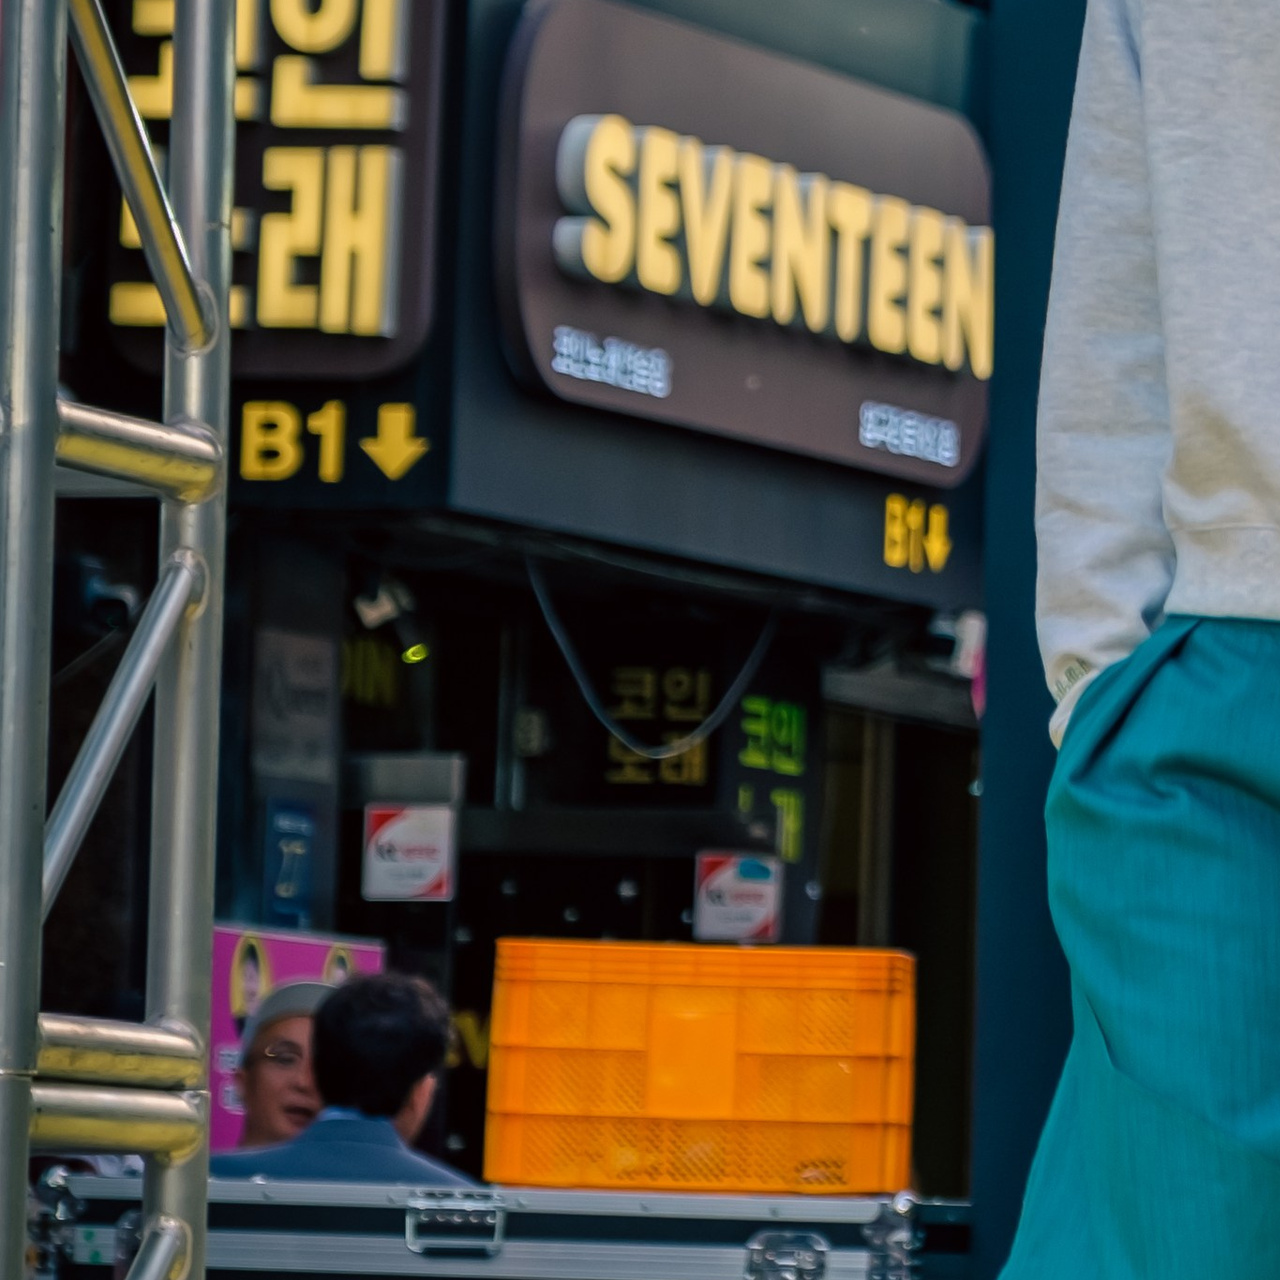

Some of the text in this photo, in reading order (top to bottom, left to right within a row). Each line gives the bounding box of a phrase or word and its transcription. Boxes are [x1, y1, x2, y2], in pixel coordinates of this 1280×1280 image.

[576, 113, 994, 380] SEVENTEEN
[240, 400, 346, 484] B1
[884, 493, 926, 573] B1
[738, 697, 806, 776] 코인
